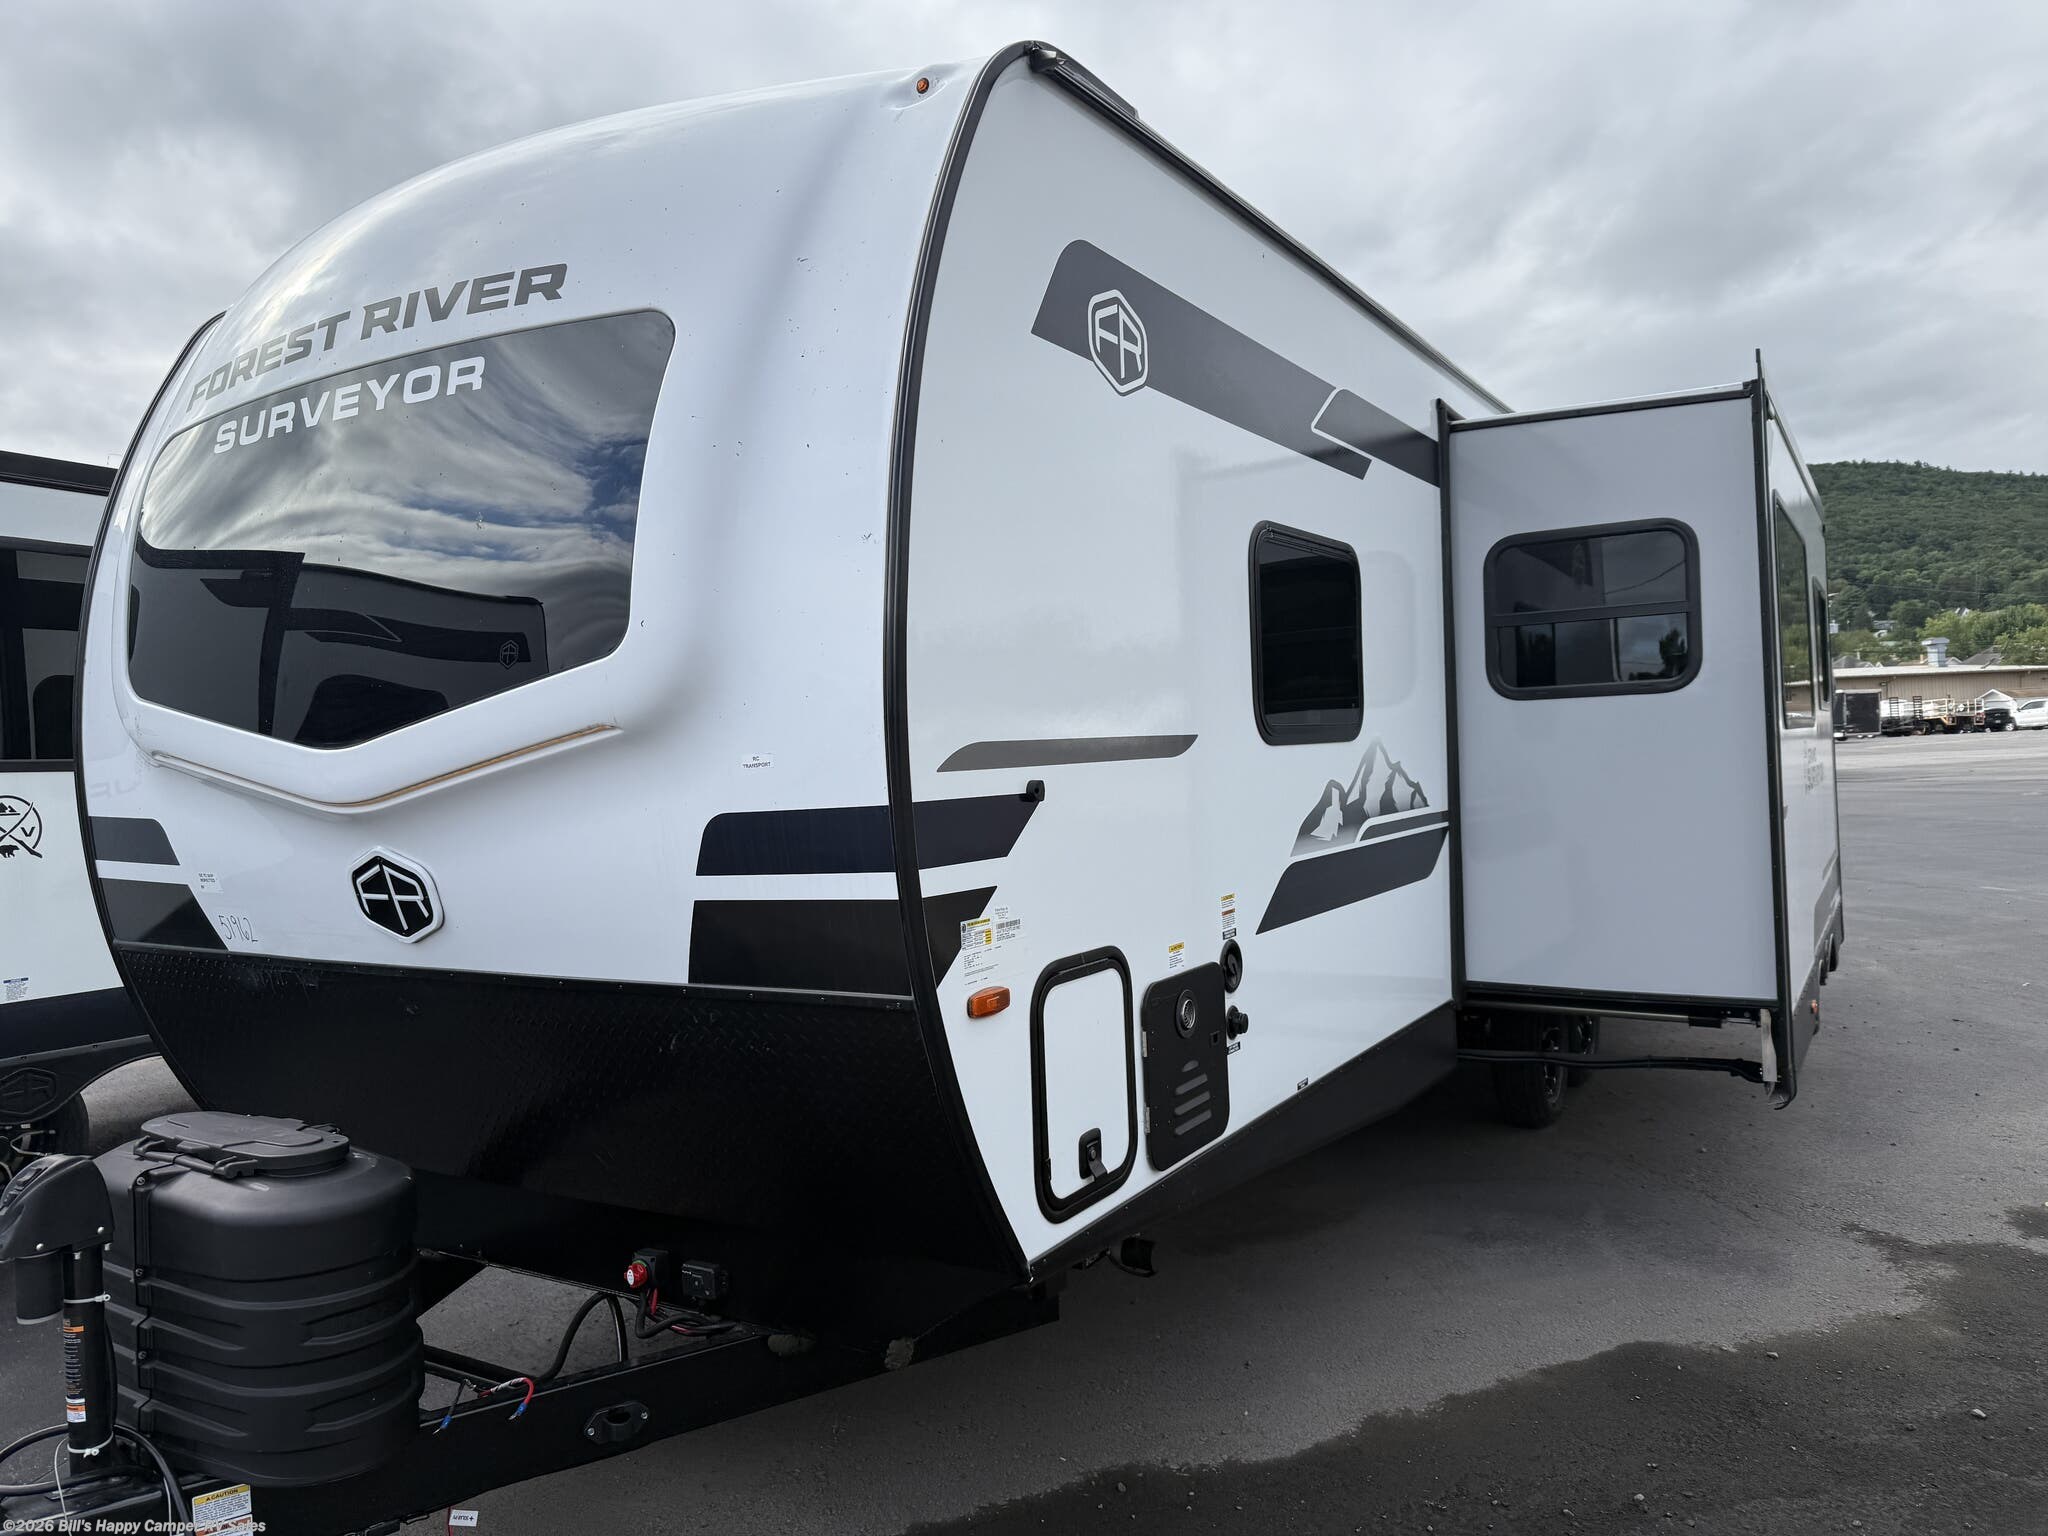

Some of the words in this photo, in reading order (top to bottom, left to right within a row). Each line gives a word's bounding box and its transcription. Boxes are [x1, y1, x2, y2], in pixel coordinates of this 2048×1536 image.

[185, 310, 351, 414] FOREST
[360, 263, 568, 341] RIVER
[213, 356, 486, 454] SURVEYOR
[218, 914, 259, 943] 51962
[211, 1488, 239, 1500] CAUTION
